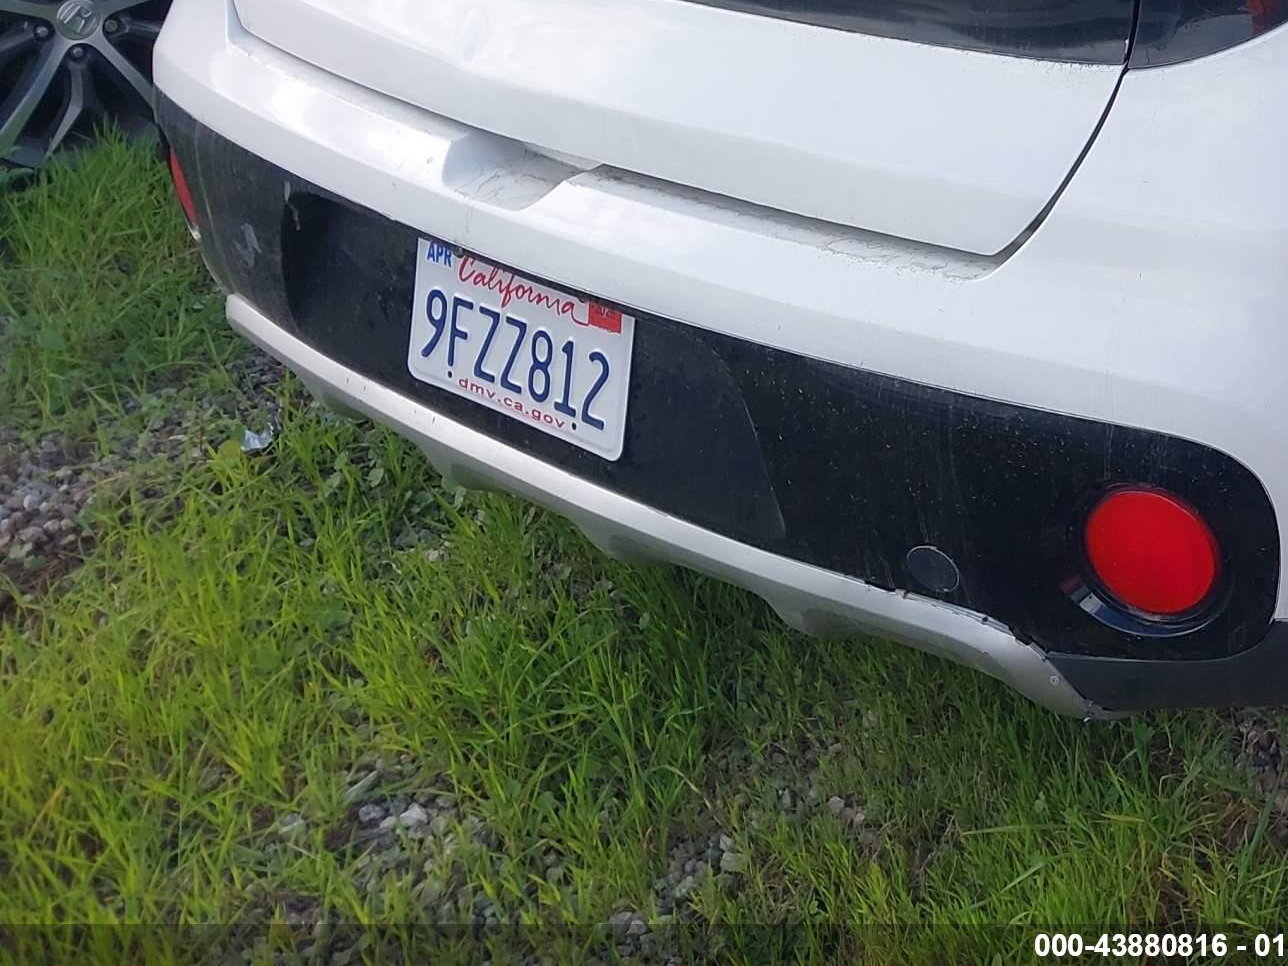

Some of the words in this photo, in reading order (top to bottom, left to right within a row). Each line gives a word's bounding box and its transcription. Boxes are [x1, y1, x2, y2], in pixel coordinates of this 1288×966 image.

[426, 241, 452, 268] APR
[458, 256, 590, 327] California
[421, 289, 610, 430] 9FZZ812
[458, 378, 566, 429] dmv.ca.gov
